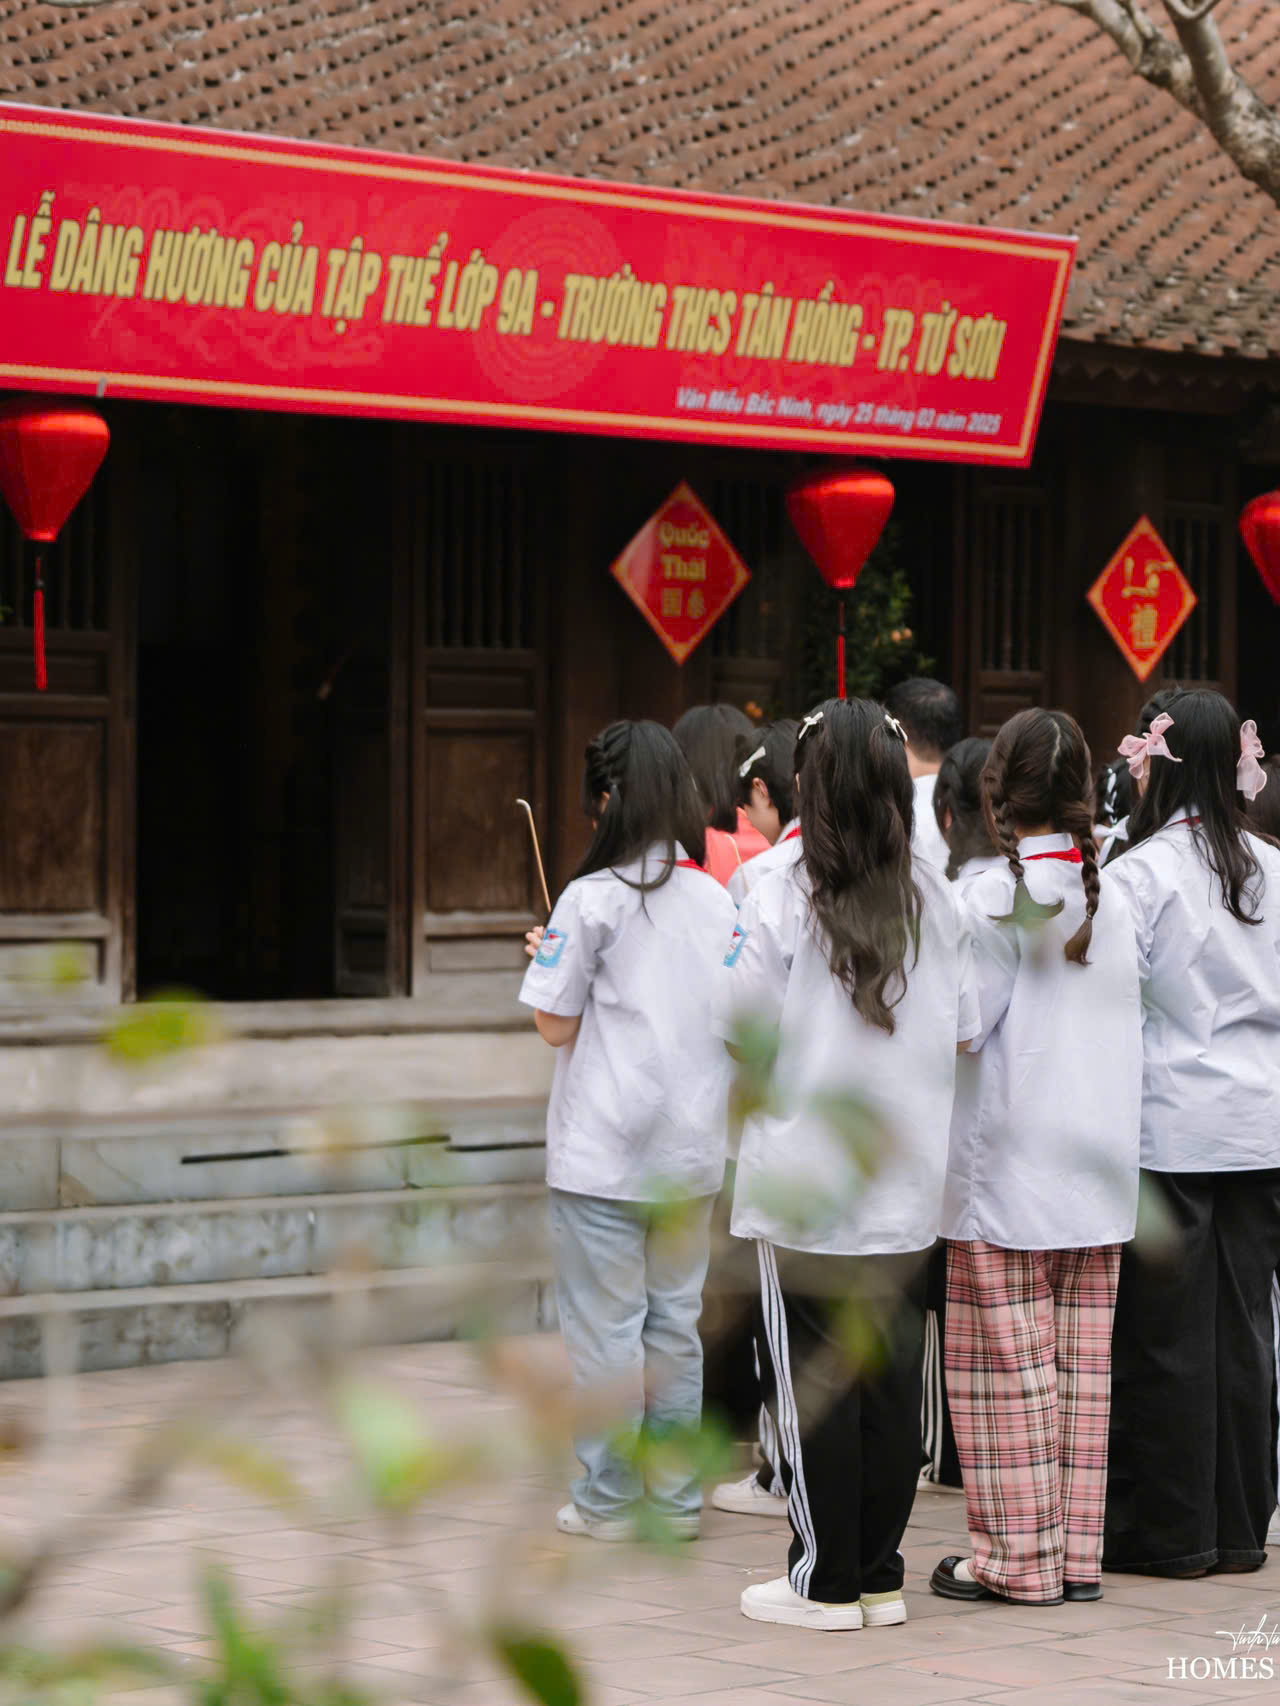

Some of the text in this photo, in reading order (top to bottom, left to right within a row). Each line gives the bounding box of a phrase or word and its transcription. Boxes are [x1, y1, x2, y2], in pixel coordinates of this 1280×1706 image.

[4, 190, 54, 286] LỄ
[51, 207, 142, 295] DÂNG
[145, 225, 253, 307] HƯƠNG
[256, 220, 318, 315] CỦA
[323, 236, 380, 332] TẬP
[383, 232, 447, 324] THỂ
[438, 248, 497, 330] LỚP
[499, 268, 538, 334] 9A
[559, 264, 666, 347] TRƯỜNG
[667, 286, 735, 354] THCS
[737, 282, 791, 358] TÂN
[788, 280, 862, 365] HỒNG
[879, 309, 912, 370] TP.
[916, 301, 956, 374] TỪ
[950, 313, 1006, 379] SƠN
[676, 386, 707, 409] Văn
[707, 387, 745, 413] Miếu
[745, 390, 776, 416] Bắc
[854, 402, 875, 424] 25
[967, 412, 1002, 435] 2025
